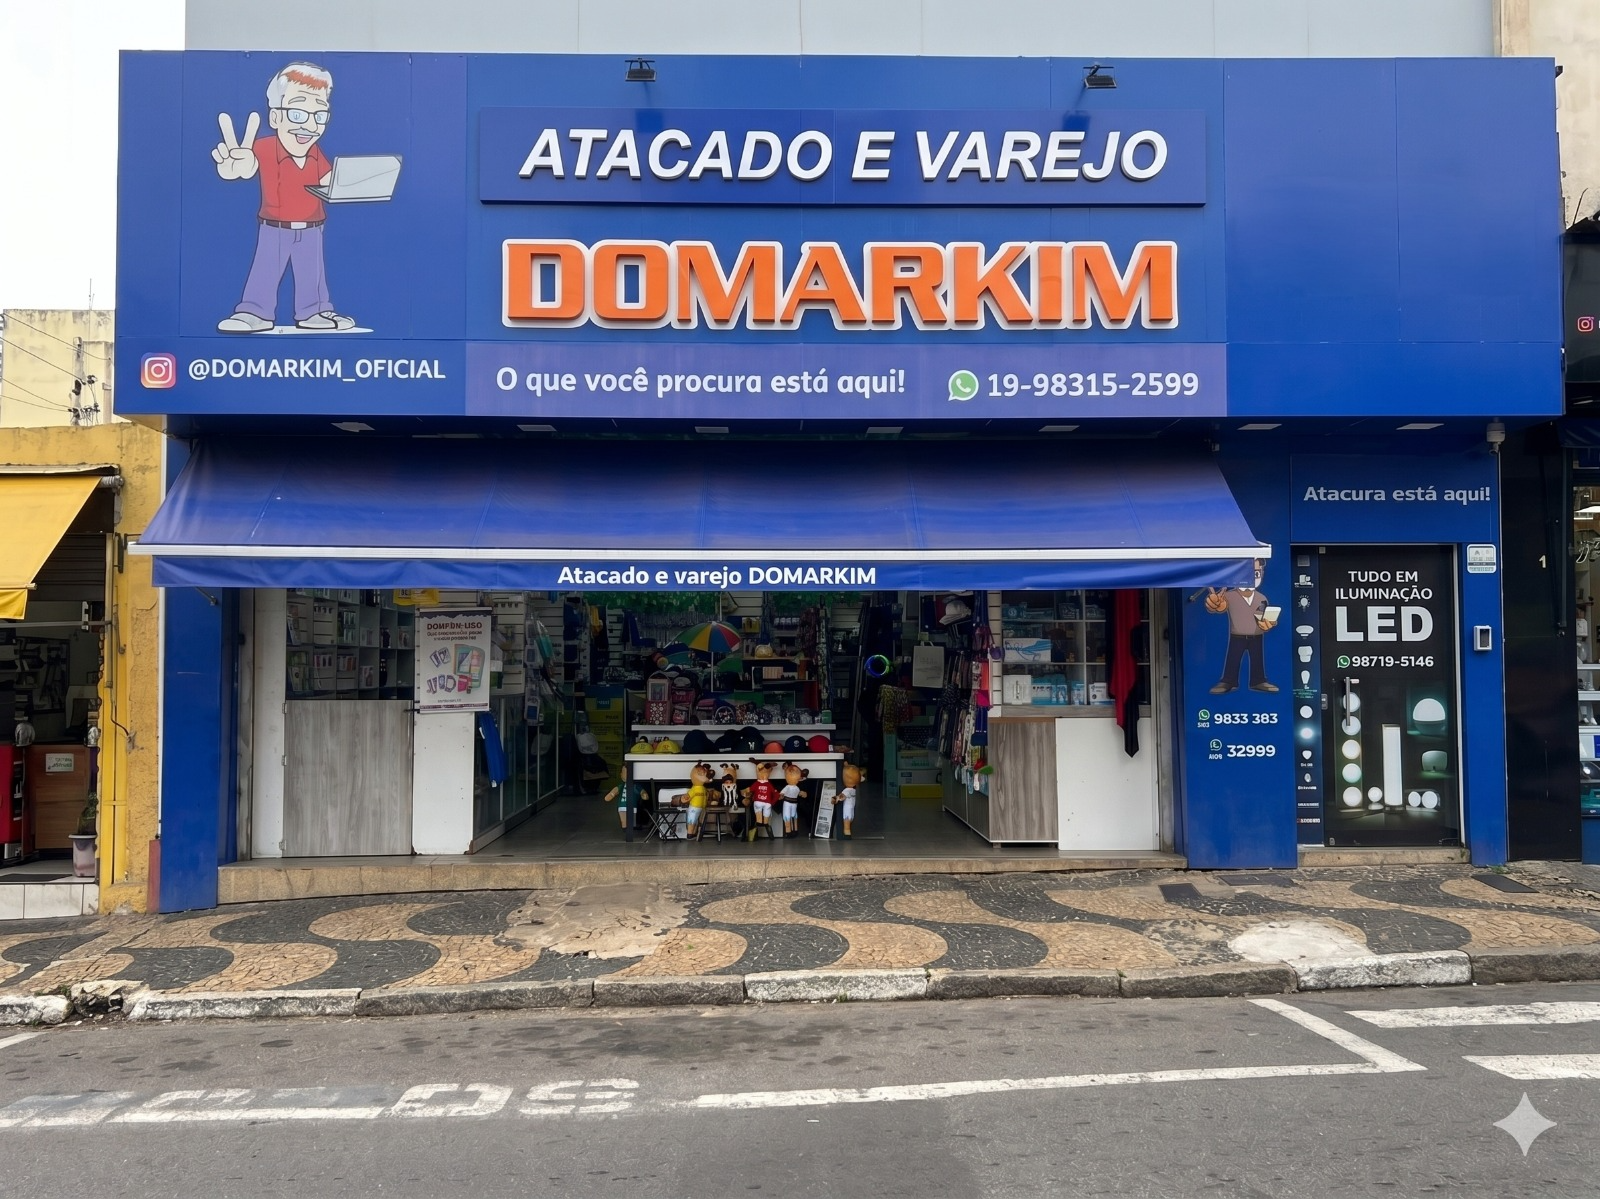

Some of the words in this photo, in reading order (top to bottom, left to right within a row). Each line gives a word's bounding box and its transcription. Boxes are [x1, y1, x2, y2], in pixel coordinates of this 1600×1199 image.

[518, 128, 834, 181] ATACADO
[850, 130, 897, 181] E
[915, 129, 1169, 182] VAREJO
[500, 238, 1179, 331] DOMARKIM
[188, 358, 447, 382] @DOMARKIM_OFICIAL
[496, 366, 518, 391] O
[525, 372, 577, 398] que
[584, 366, 649, 392] você
[656, 374, 762, 399] procura
[770, 367, 829, 393] está
[837, 368, 906, 399] aqui!
[986, 372, 1199, 397] 19-98315-2599
[1303, 486, 1386, 501] Atacura
[1392, 485, 1437, 501] está
[1443, 486, 1491, 506] aqui!
[557, 566, 650, 585] Atacado
[655, 570, 669, 585] e
[674, 566, 742, 589] varejo
[749, 566, 877, 586] DOMARKIM
[1347, 570, 1392, 583] TUDO
[1395, 570, 1419, 583] EM
[1335, 583, 1433, 602] ILUMINAÇÃO
[1335, 605, 1434, 642] LED
[1351, 655, 1434, 668] 98719-5146
[1214, 713, 1249, 725] 9833
[1252, 713, 1278, 724] 383
[1226, 744, 1276, 758] 32999
